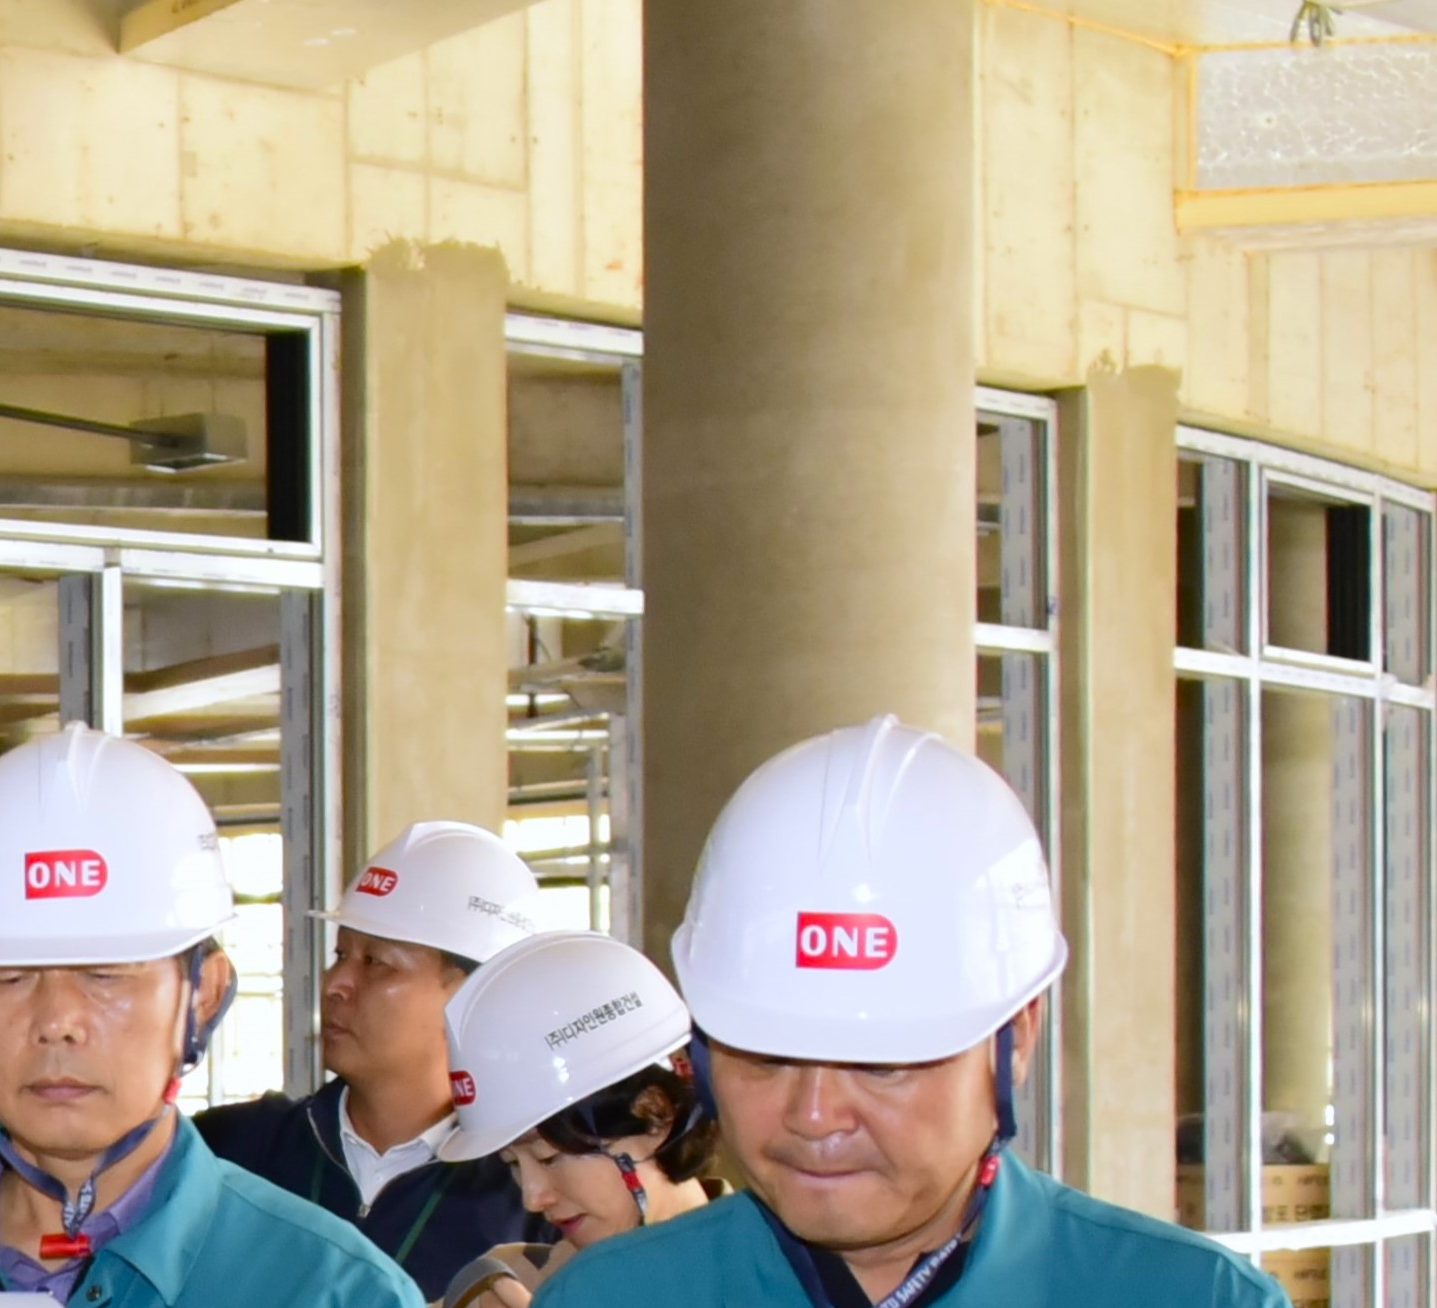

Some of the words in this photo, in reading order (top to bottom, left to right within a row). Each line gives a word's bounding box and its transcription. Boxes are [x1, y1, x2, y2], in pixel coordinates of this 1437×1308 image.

[28, 859, 101, 889] ONE
[362, 871, 395, 893] ONE
[801, 925, 890, 959] ONE
[453, 1079, 474, 1098] NE
